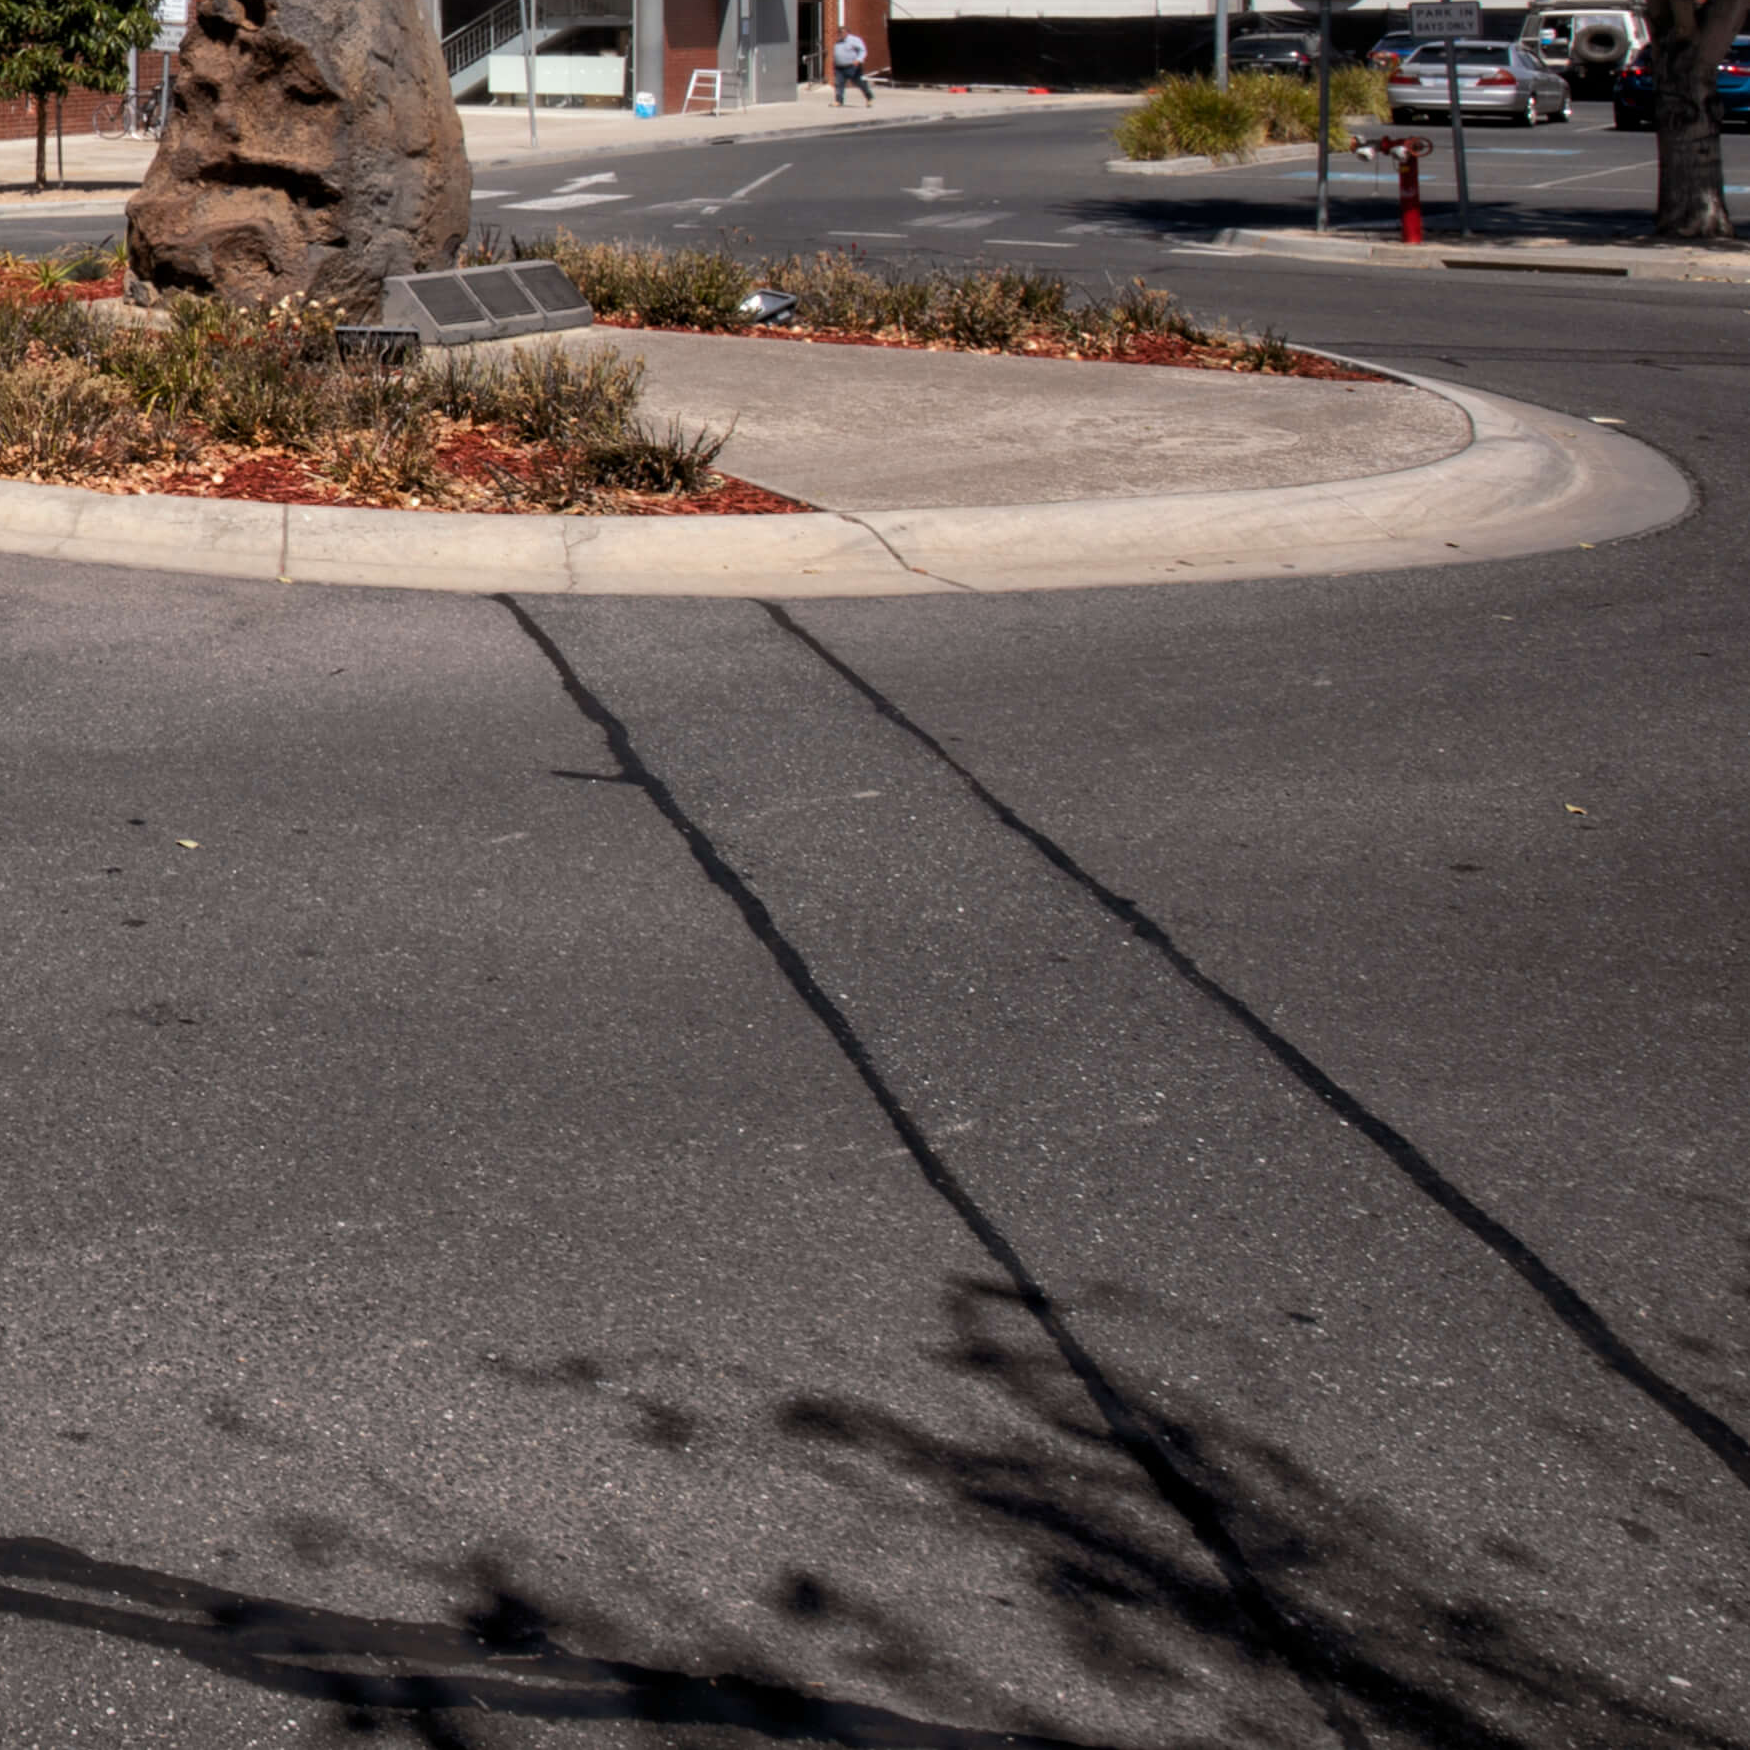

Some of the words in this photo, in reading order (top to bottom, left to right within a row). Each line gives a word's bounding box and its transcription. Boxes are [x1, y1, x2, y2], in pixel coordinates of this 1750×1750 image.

[1416, 8, 1453, 19] PARK
[1460, 7, 1474, 17] IN
[1444, 20, 1475, 31] ONLY
